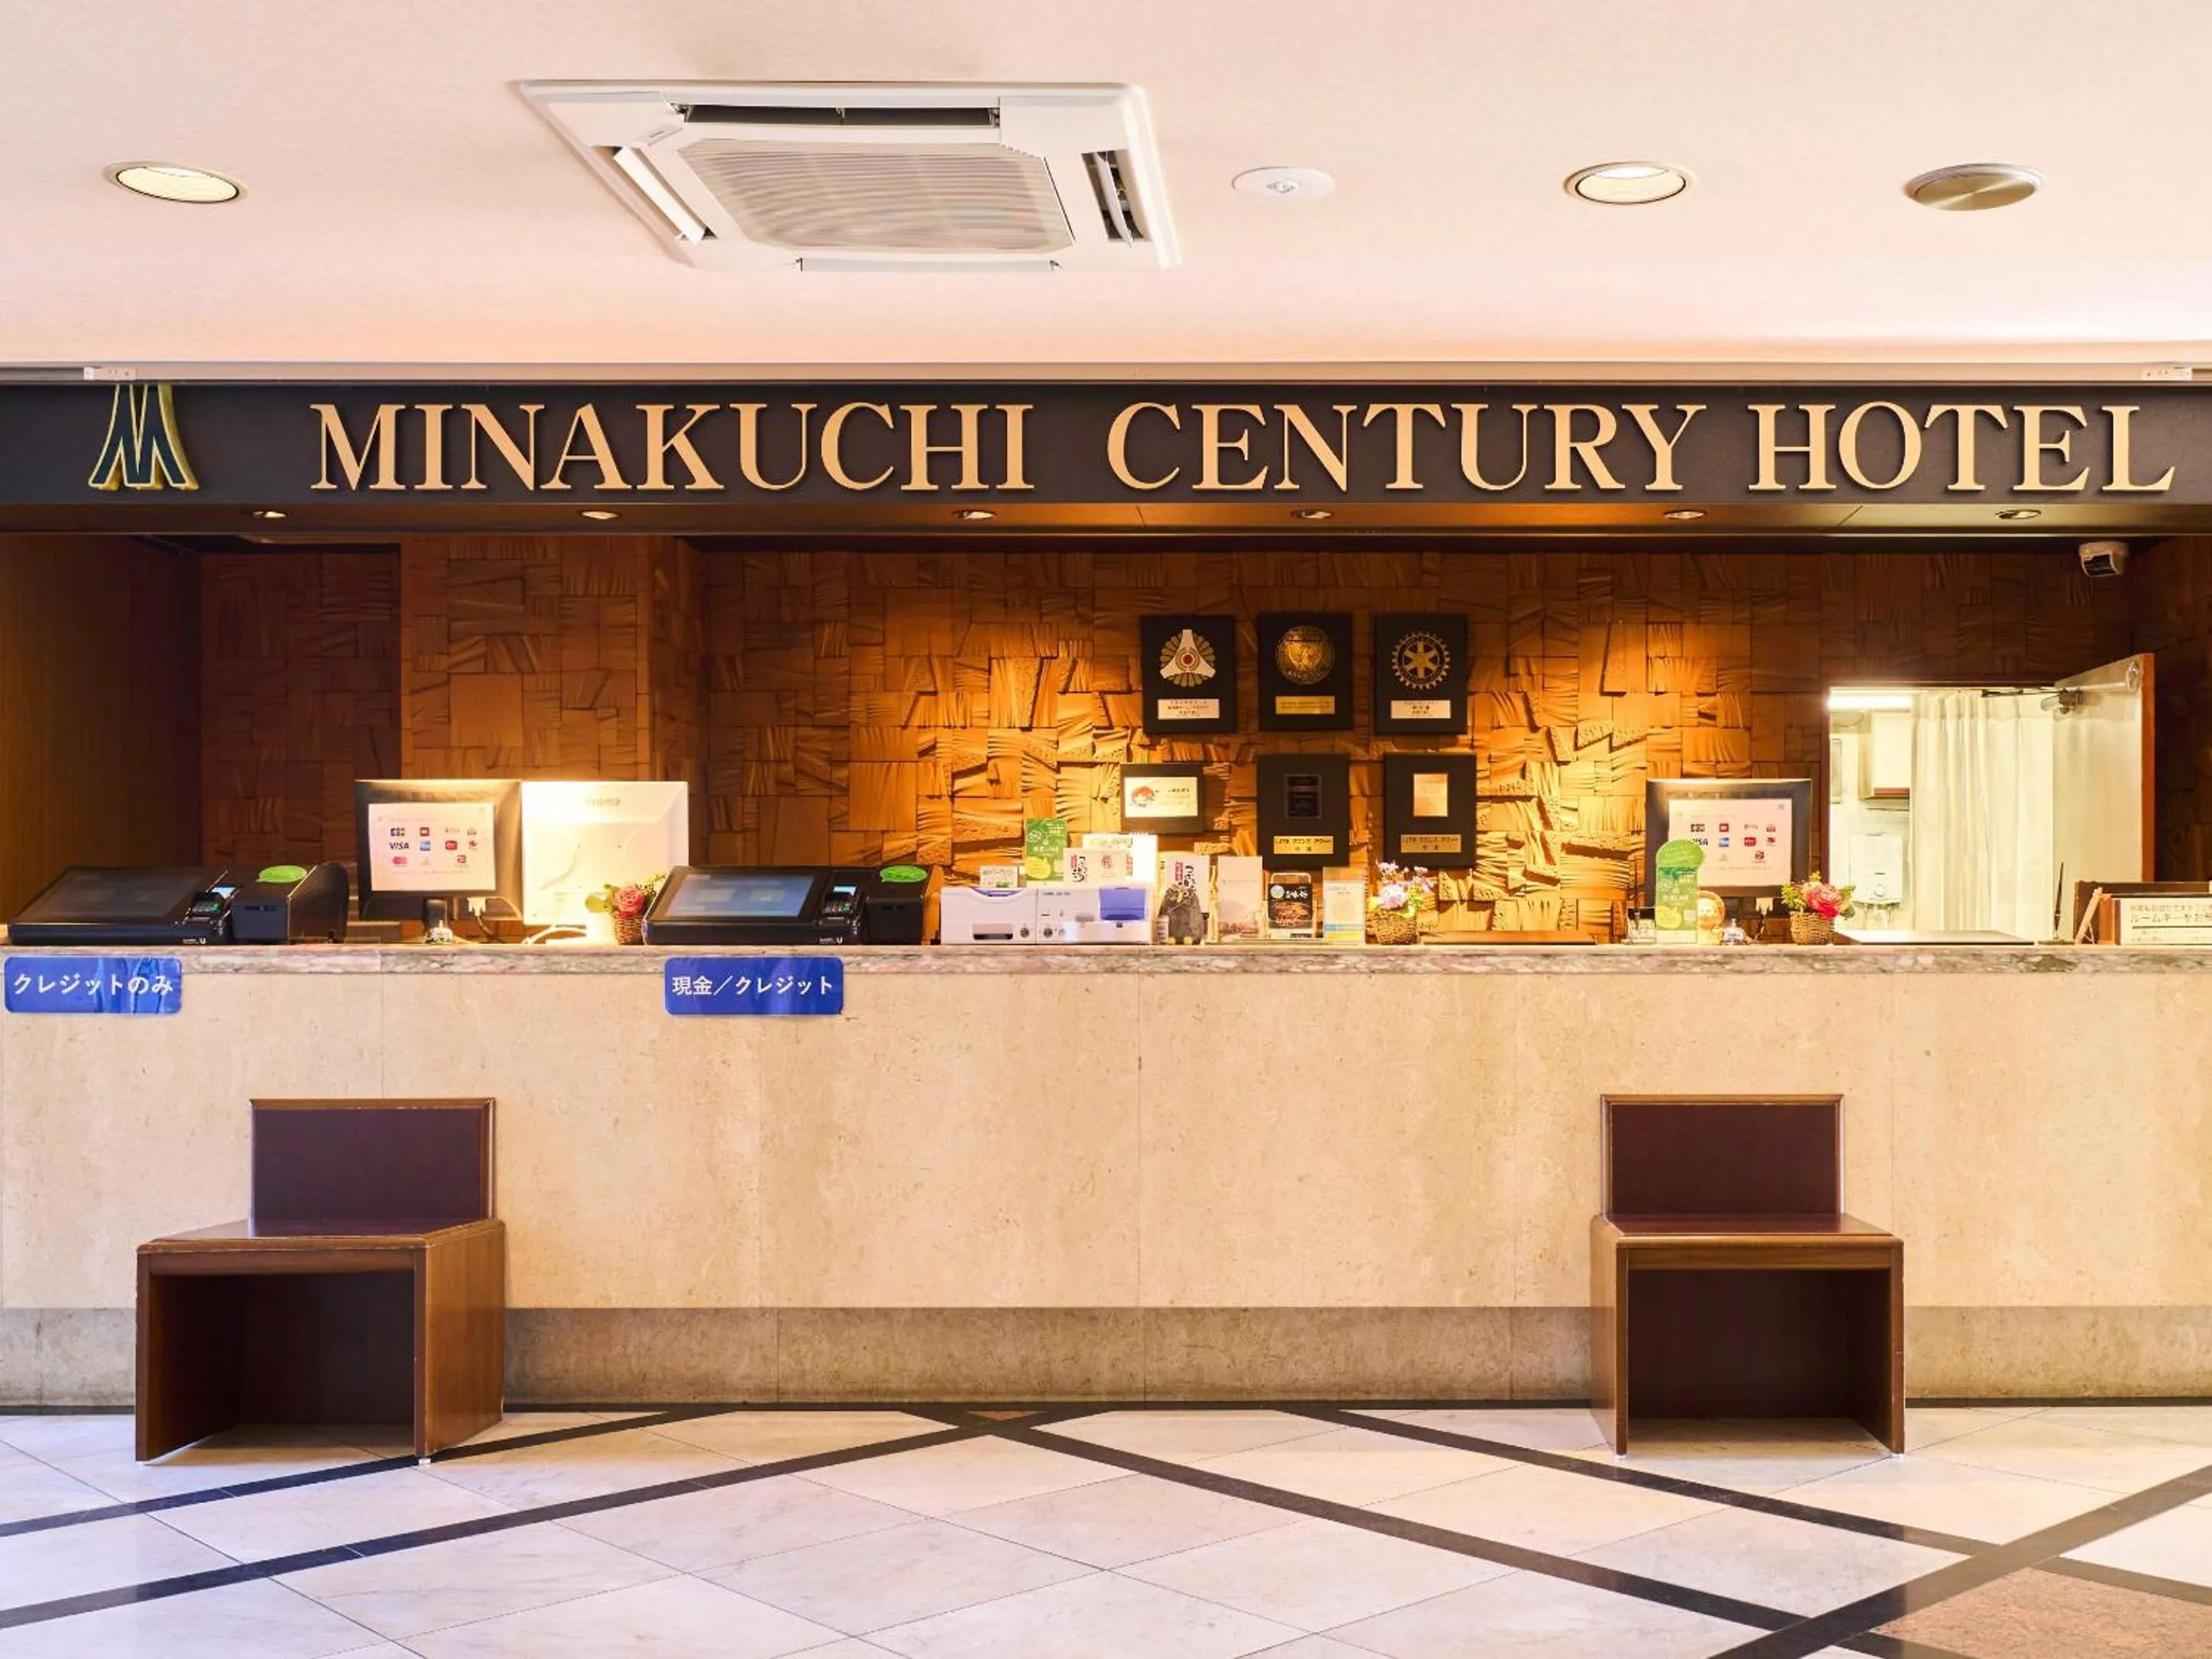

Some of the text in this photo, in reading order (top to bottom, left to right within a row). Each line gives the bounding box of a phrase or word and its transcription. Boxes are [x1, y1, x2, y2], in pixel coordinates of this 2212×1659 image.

[310, 401, 2177, 492] MINAKUCHI CENTURY HOTEL
[389, 842, 410, 850] VISA
[14, 972, 174, 996] クレジットのみ
[671, 975, 833, 996] 現金／クレジット
